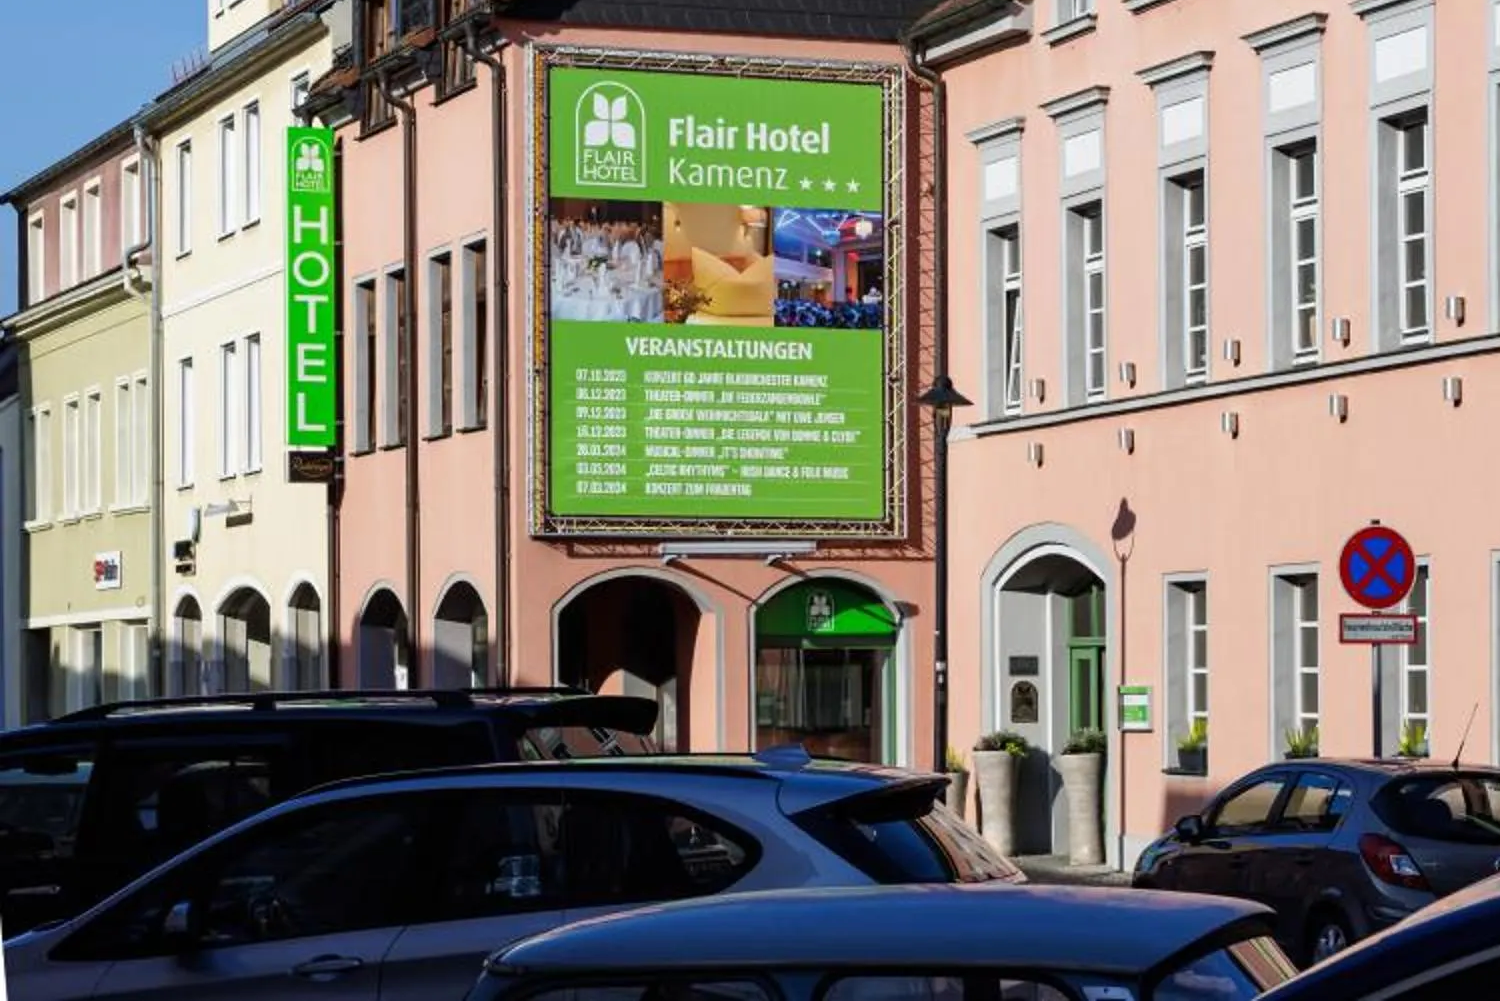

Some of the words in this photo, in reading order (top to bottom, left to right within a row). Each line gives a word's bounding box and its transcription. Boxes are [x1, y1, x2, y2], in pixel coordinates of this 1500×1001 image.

[669, 115, 739, 150] Flair
[747, 122, 830, 154] Hotel
[583, 150, 634, 165] FLAIR
[583, 164, 638, 182] HOTEL
[669, 157, 788, 190] Kamenz
[293, 205, 330, 432] HOTEL
[626, 337, 813, 360] VERANSTALTUNGEN
